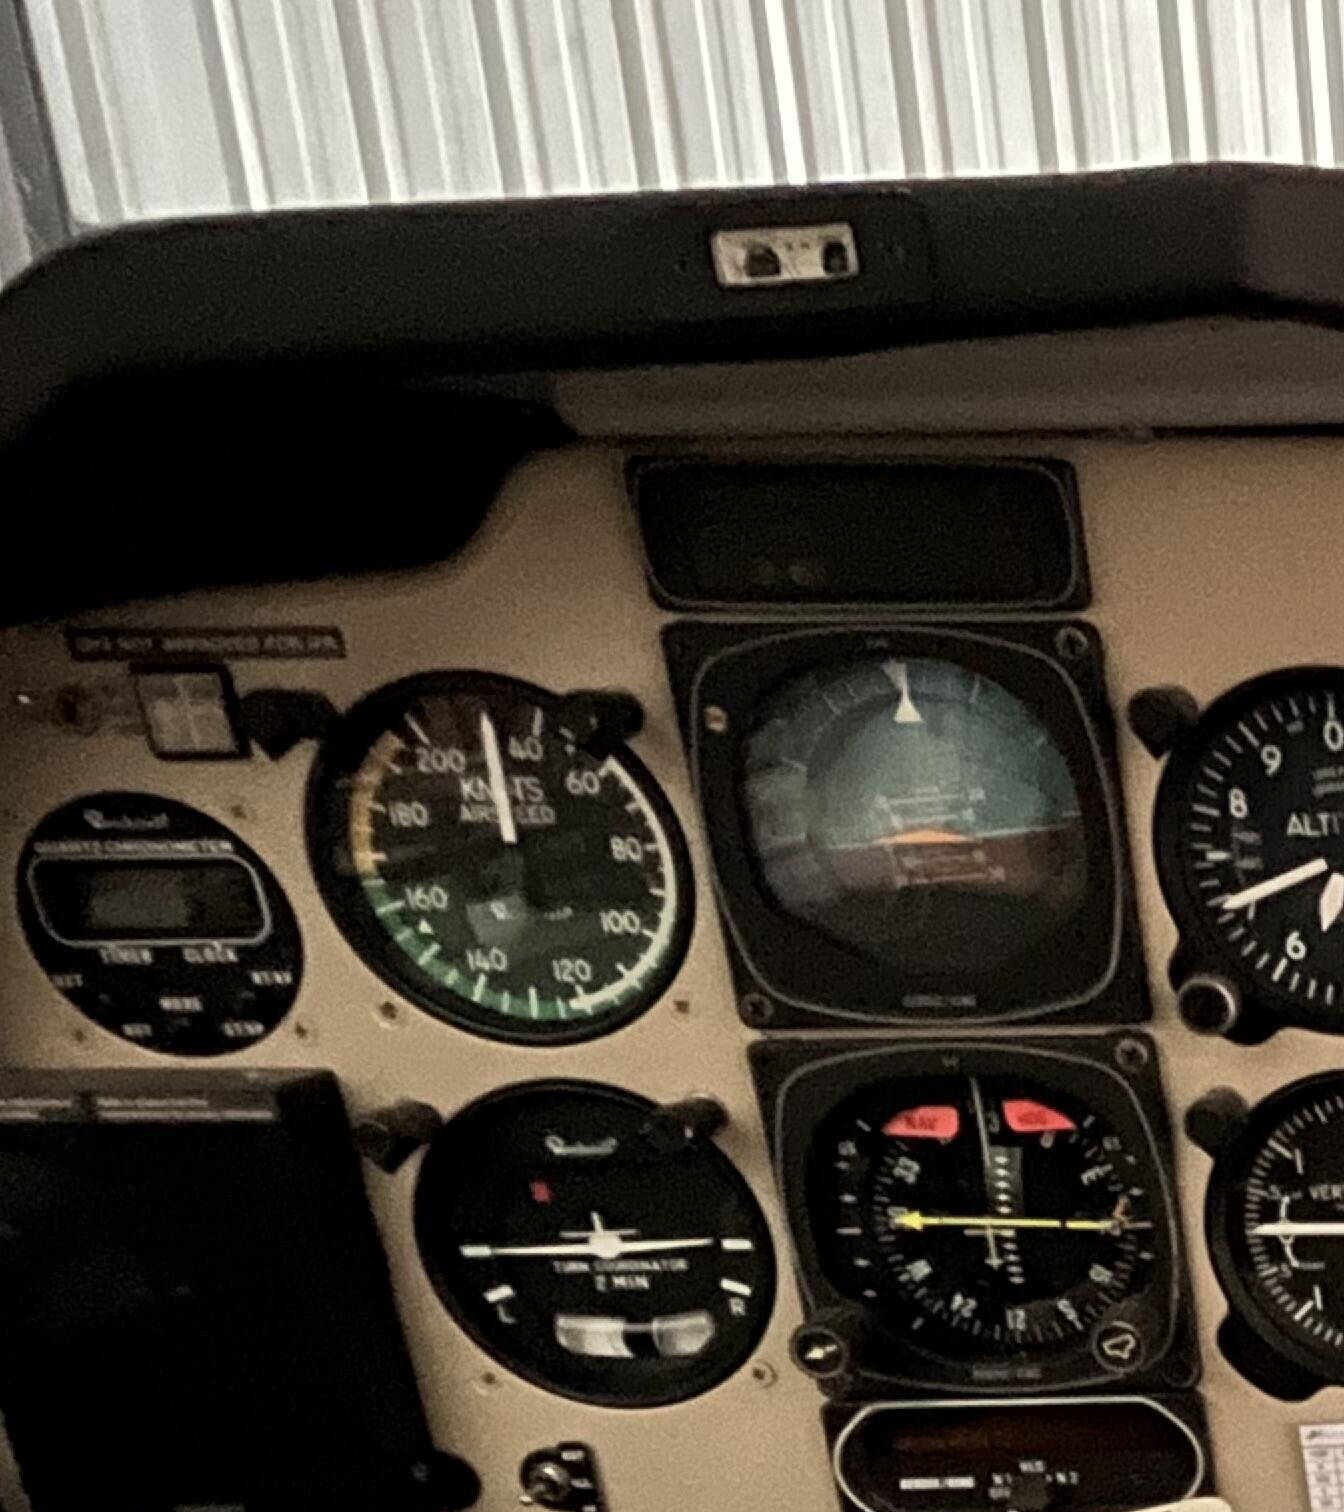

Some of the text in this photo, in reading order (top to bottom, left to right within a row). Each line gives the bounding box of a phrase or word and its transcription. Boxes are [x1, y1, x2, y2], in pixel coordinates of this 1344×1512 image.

[508, 738, 543, 761] 40
[1260, 744, 1282, 777] 9
[416, 750, 466, 774] 200
[460, 776, 544, 802] KNTS
[565, 770, 600, 796] 60
[388, 802, 429, 827] 180
[1228, 787, 1249, 819] 8
[610, 837, 643, 861] 80
[405, 886, 448, 909] 160
[601, 910, 640, 934] 100
[1285, 931, 1308, 961] 6
[467, 946, 507, 972] 140
[552, 960, 591, 983] 120
[612, 1273, 650, 1290] MIN
